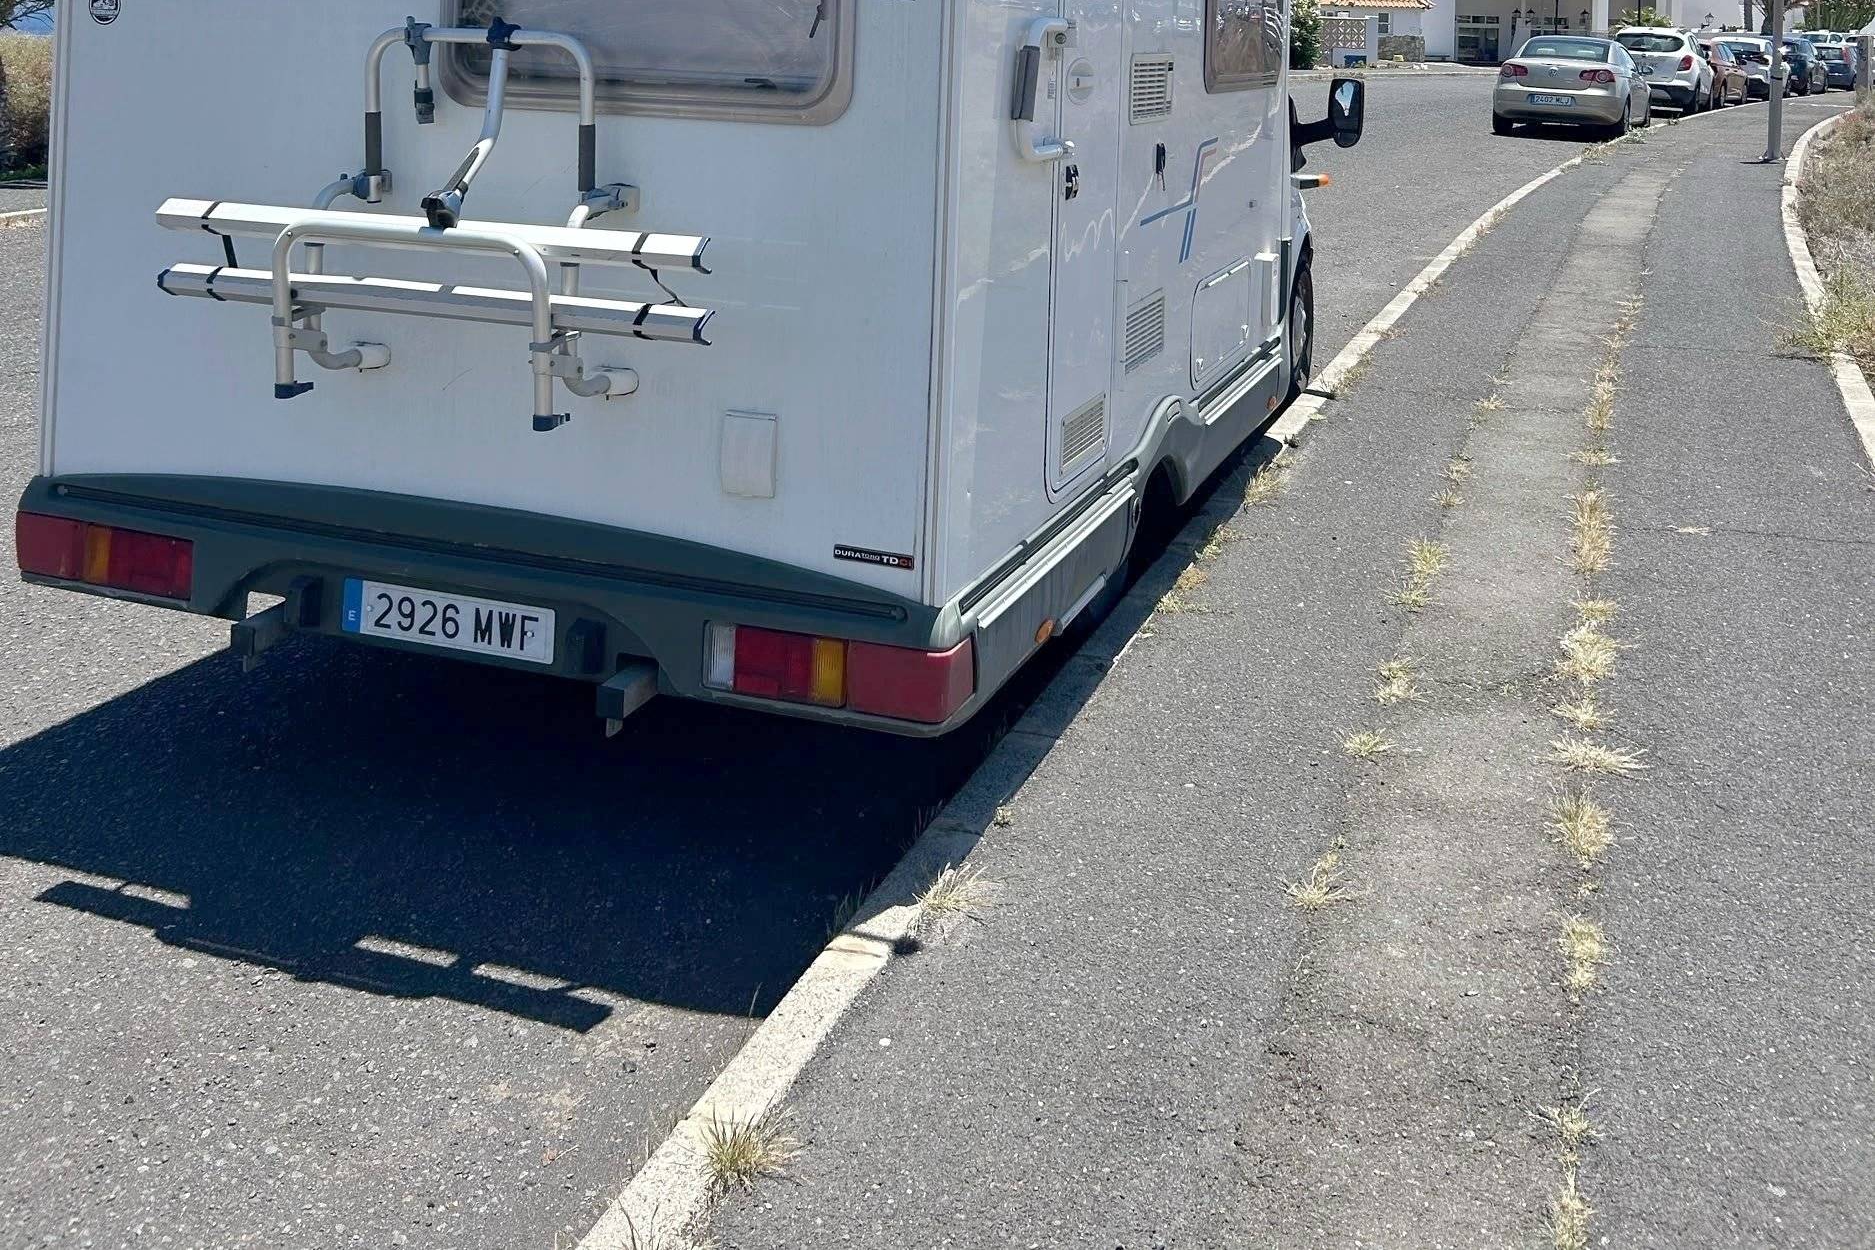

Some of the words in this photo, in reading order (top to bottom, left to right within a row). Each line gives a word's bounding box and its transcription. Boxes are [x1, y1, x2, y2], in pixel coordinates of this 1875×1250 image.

[348, 609, 356, 621] E
[374, 592, 460, 639] 2926
[473, 607, 539, 651] MWF
